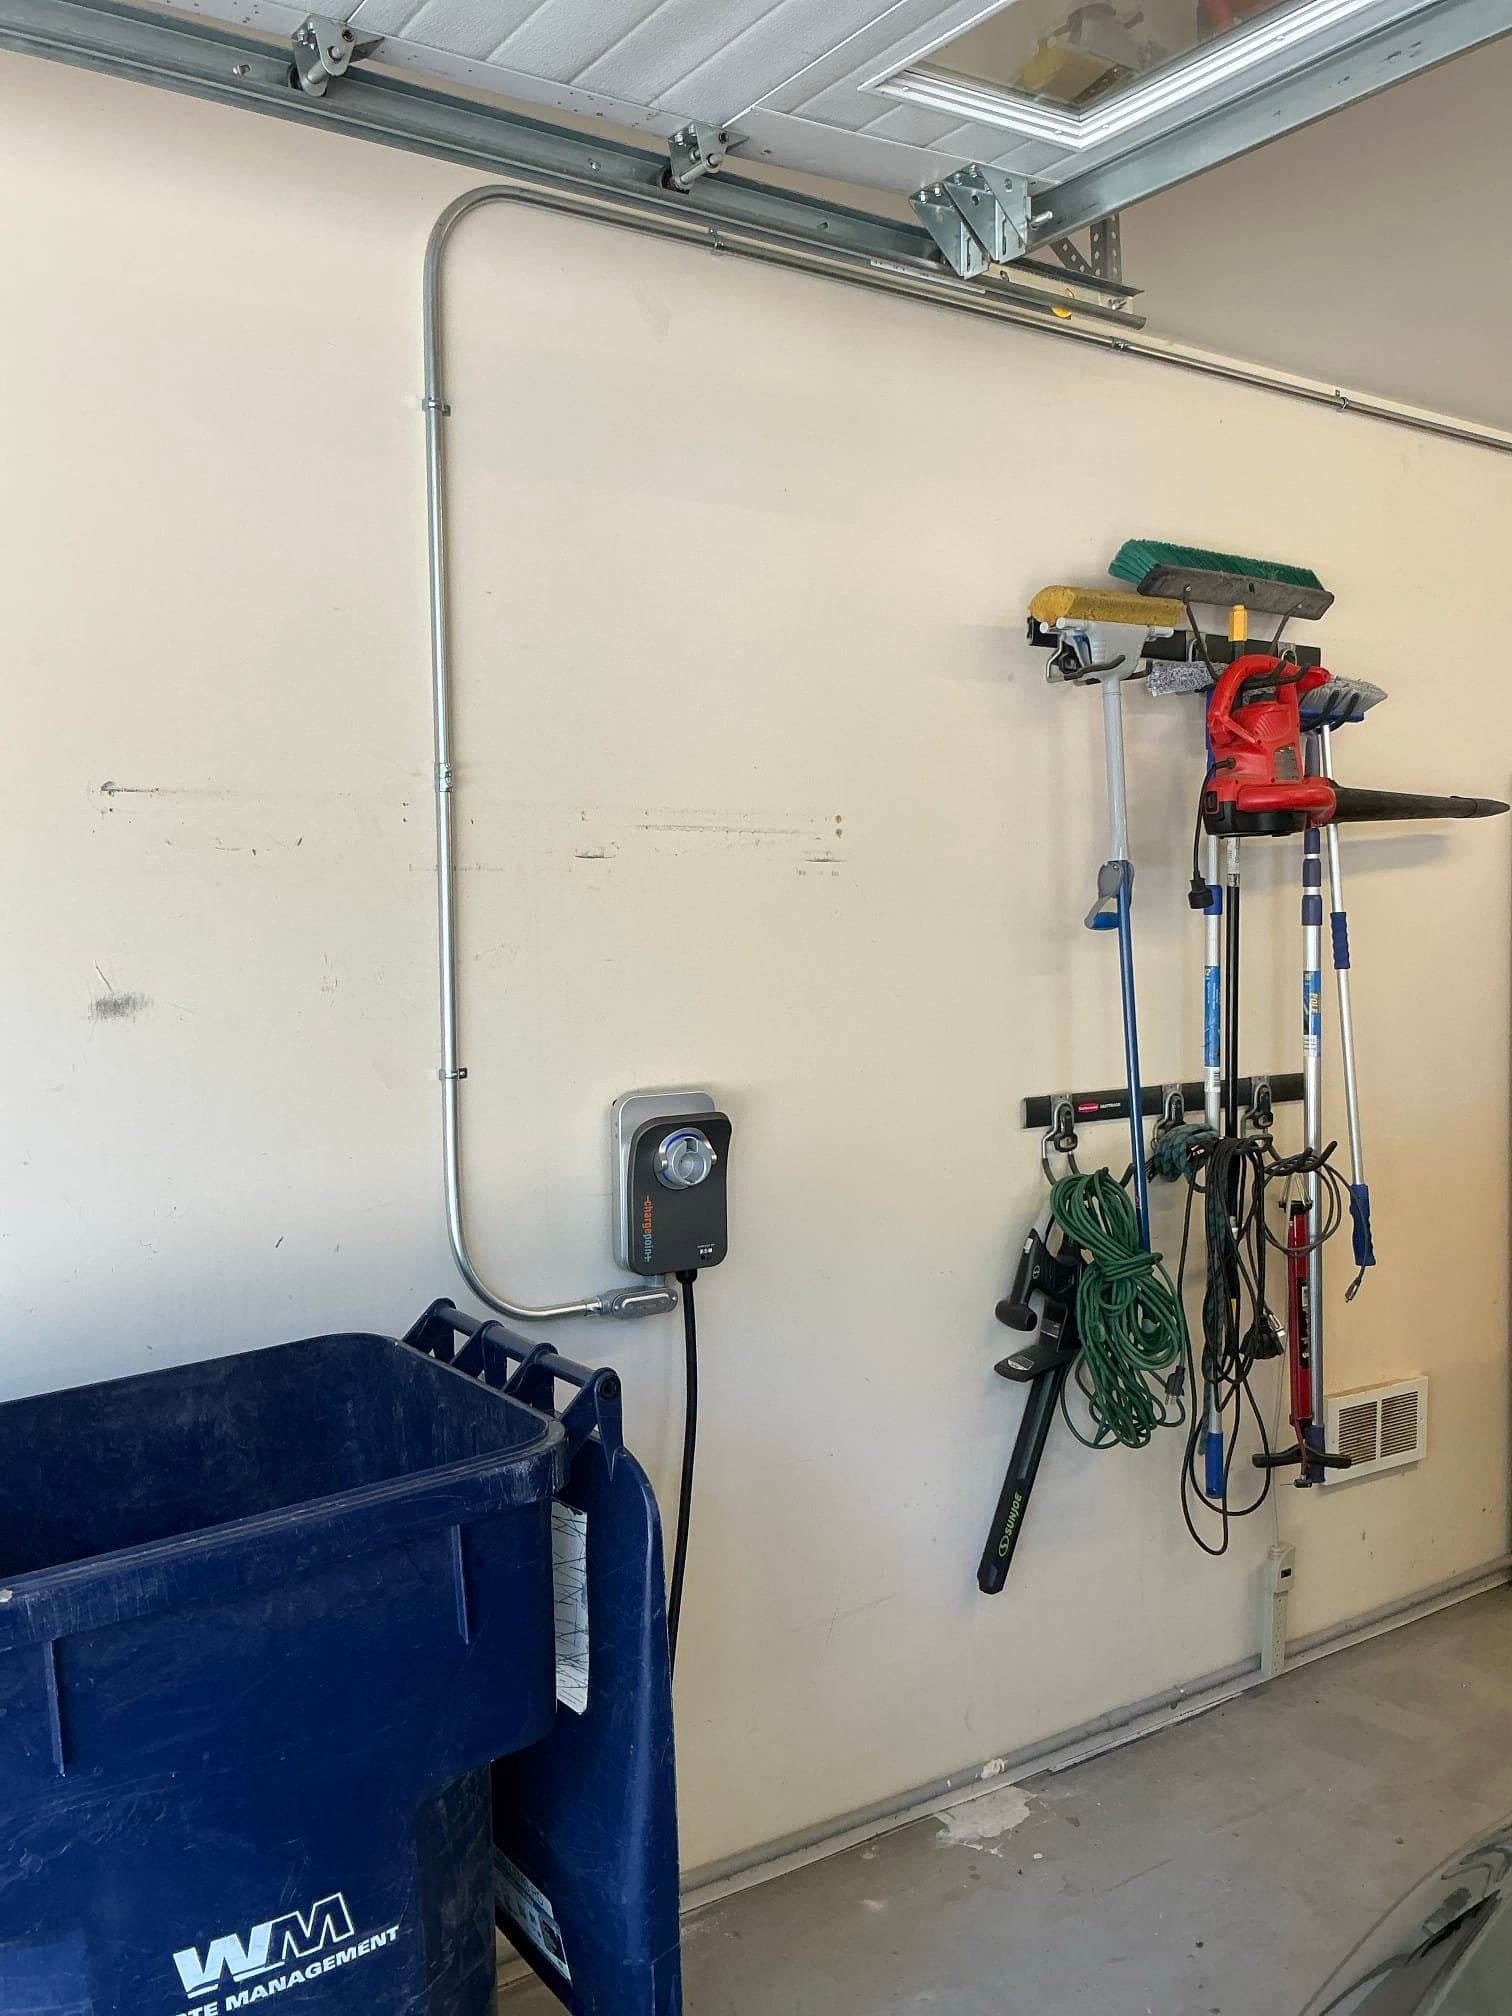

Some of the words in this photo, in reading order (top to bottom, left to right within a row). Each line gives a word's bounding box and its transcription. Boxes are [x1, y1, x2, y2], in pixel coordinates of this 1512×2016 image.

[173, 1891, 355, 1997] WM
[176, 2001, 219, 2016] TE
[225, 1924, 401, 2012] MANAGEMENT
